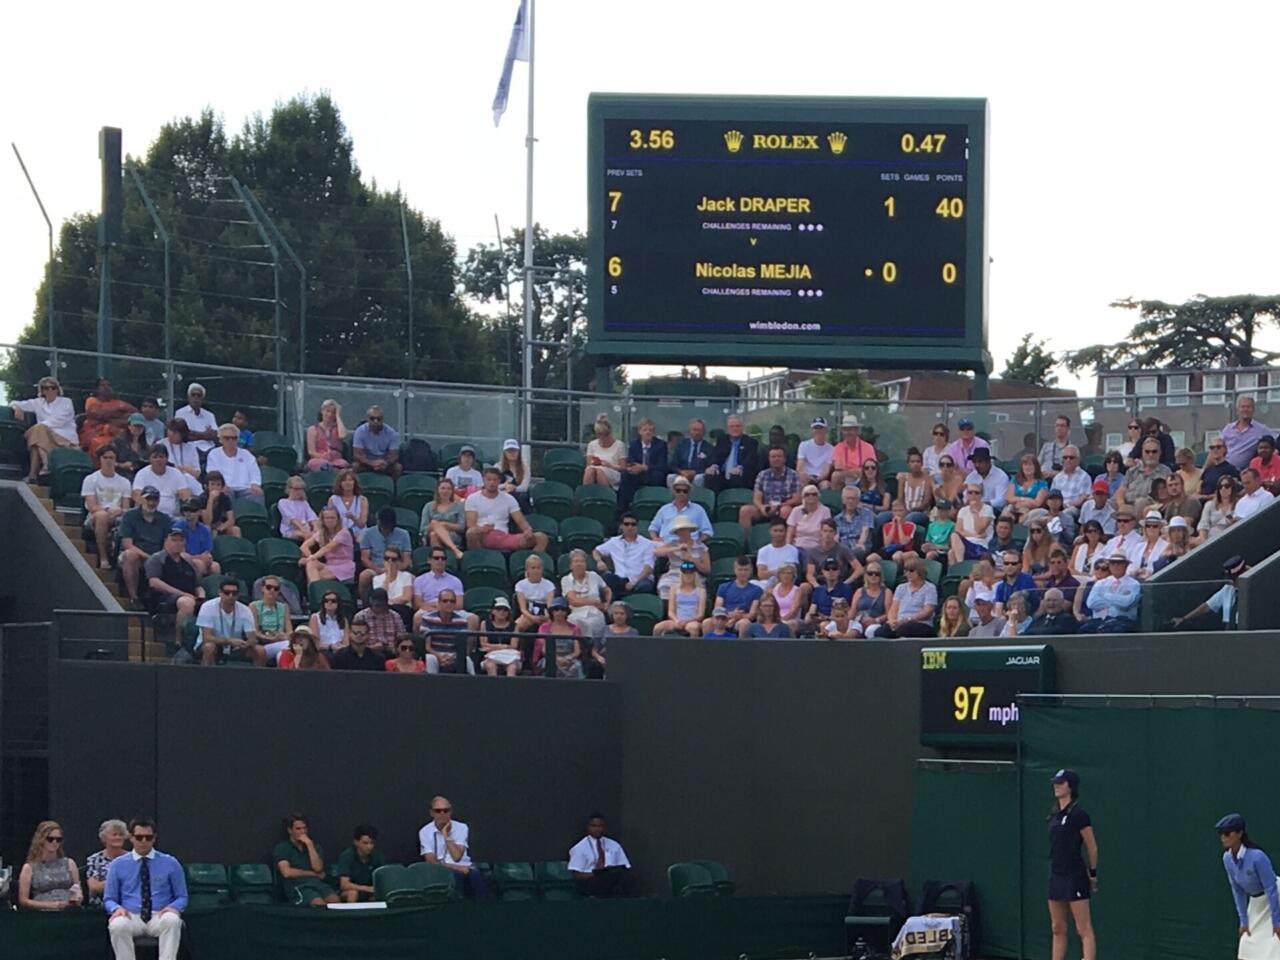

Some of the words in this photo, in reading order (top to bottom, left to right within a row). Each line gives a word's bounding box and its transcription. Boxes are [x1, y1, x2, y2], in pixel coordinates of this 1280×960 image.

[629, 129, 674, 149] 3.56
[752, 134, 820, 149] ROLEX
[901, 133, 947, 153] 0.47
[607, 169, 625, 177] PREV
[626, 169, 643, 177] SETS
[880, 173, 900, 181] SETS
[903, 173, 930, 182] GAMES
[936, 174, 963, 182] POINTS
[608, 191, 622, 212] 7
[697, 196, 736, 212] Jack
[740, 197, 811, 213] DRAPER
[884, 196, 895, 217] 1
[935, 198, 964, 218] 40
[702, 222, 750, 230] CHALLENGES
[752, 223, 792, 231] REMAINING
[608, 256, 622, 277] 6
[695, 262, 756, 278] Nicolas
[760, 264, 812, 279] MEJIA
[882, 262, 897, 282] 0
[942, 263, 957, 283] 0
[702, 287, 750, 296] CHALLENGES
[751, 289, 791, 297] REMAINING
[749, 321, 821, 331] wimbledon.com
[922, 651, 946, 669] IBM
[954, 686, 984, 720] 97
[989, 702, 1019, 726] mph
